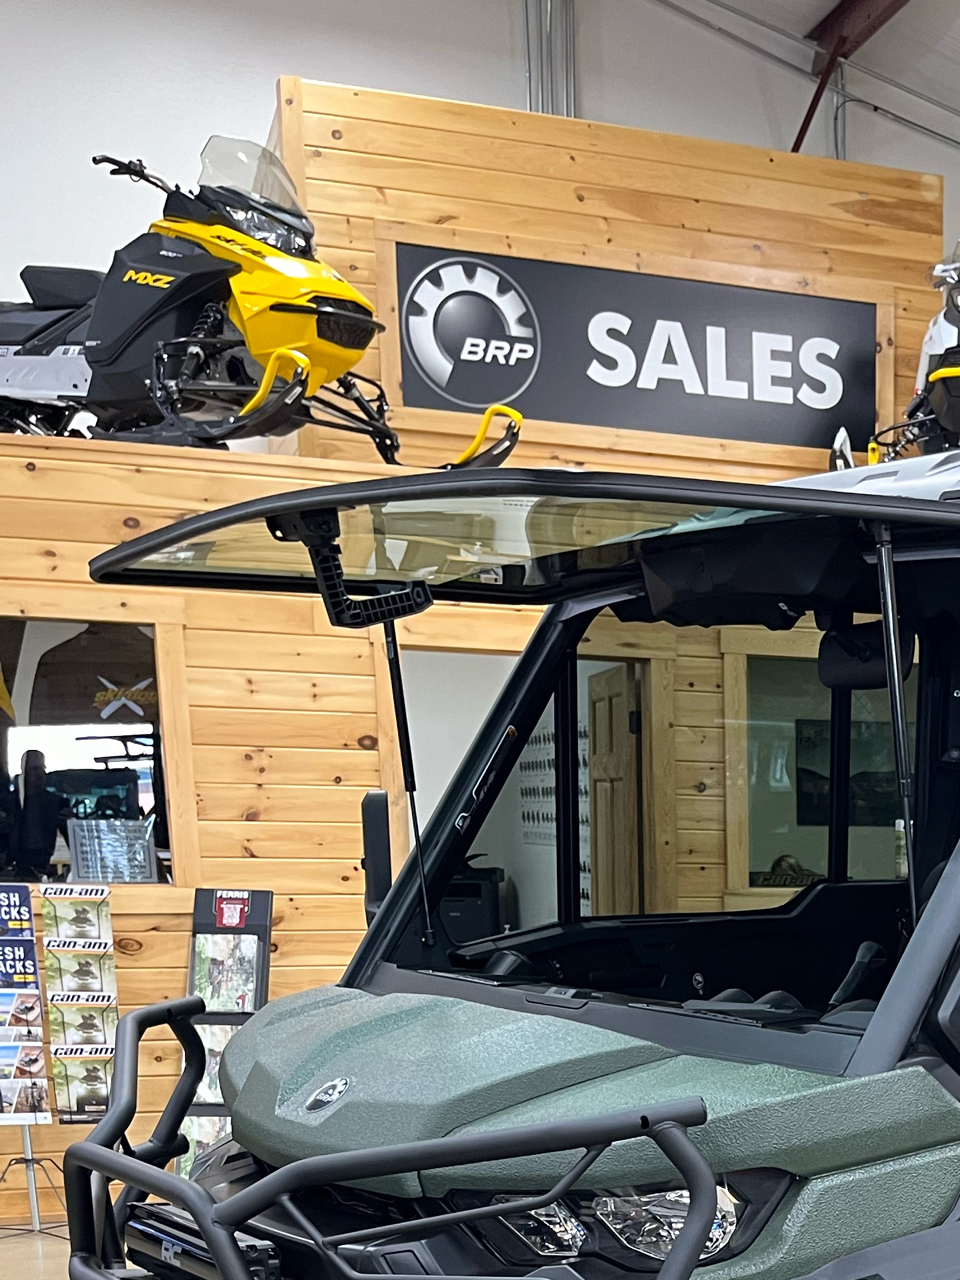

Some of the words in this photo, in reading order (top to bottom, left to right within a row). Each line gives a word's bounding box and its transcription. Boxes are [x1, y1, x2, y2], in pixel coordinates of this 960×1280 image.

[123, 269, 175, 289] MXZ
[460, 337, 534, 366] BRP
[586, 311, 844, 410] SALES
[43, 886, 105, 897] can-am
[216, 890, 249, 899] FERRIS
[46, 939, 108, 950] can-am
[50, 993, 111, 1003] can-am
[53, 1046, 115, 1056] can-am
